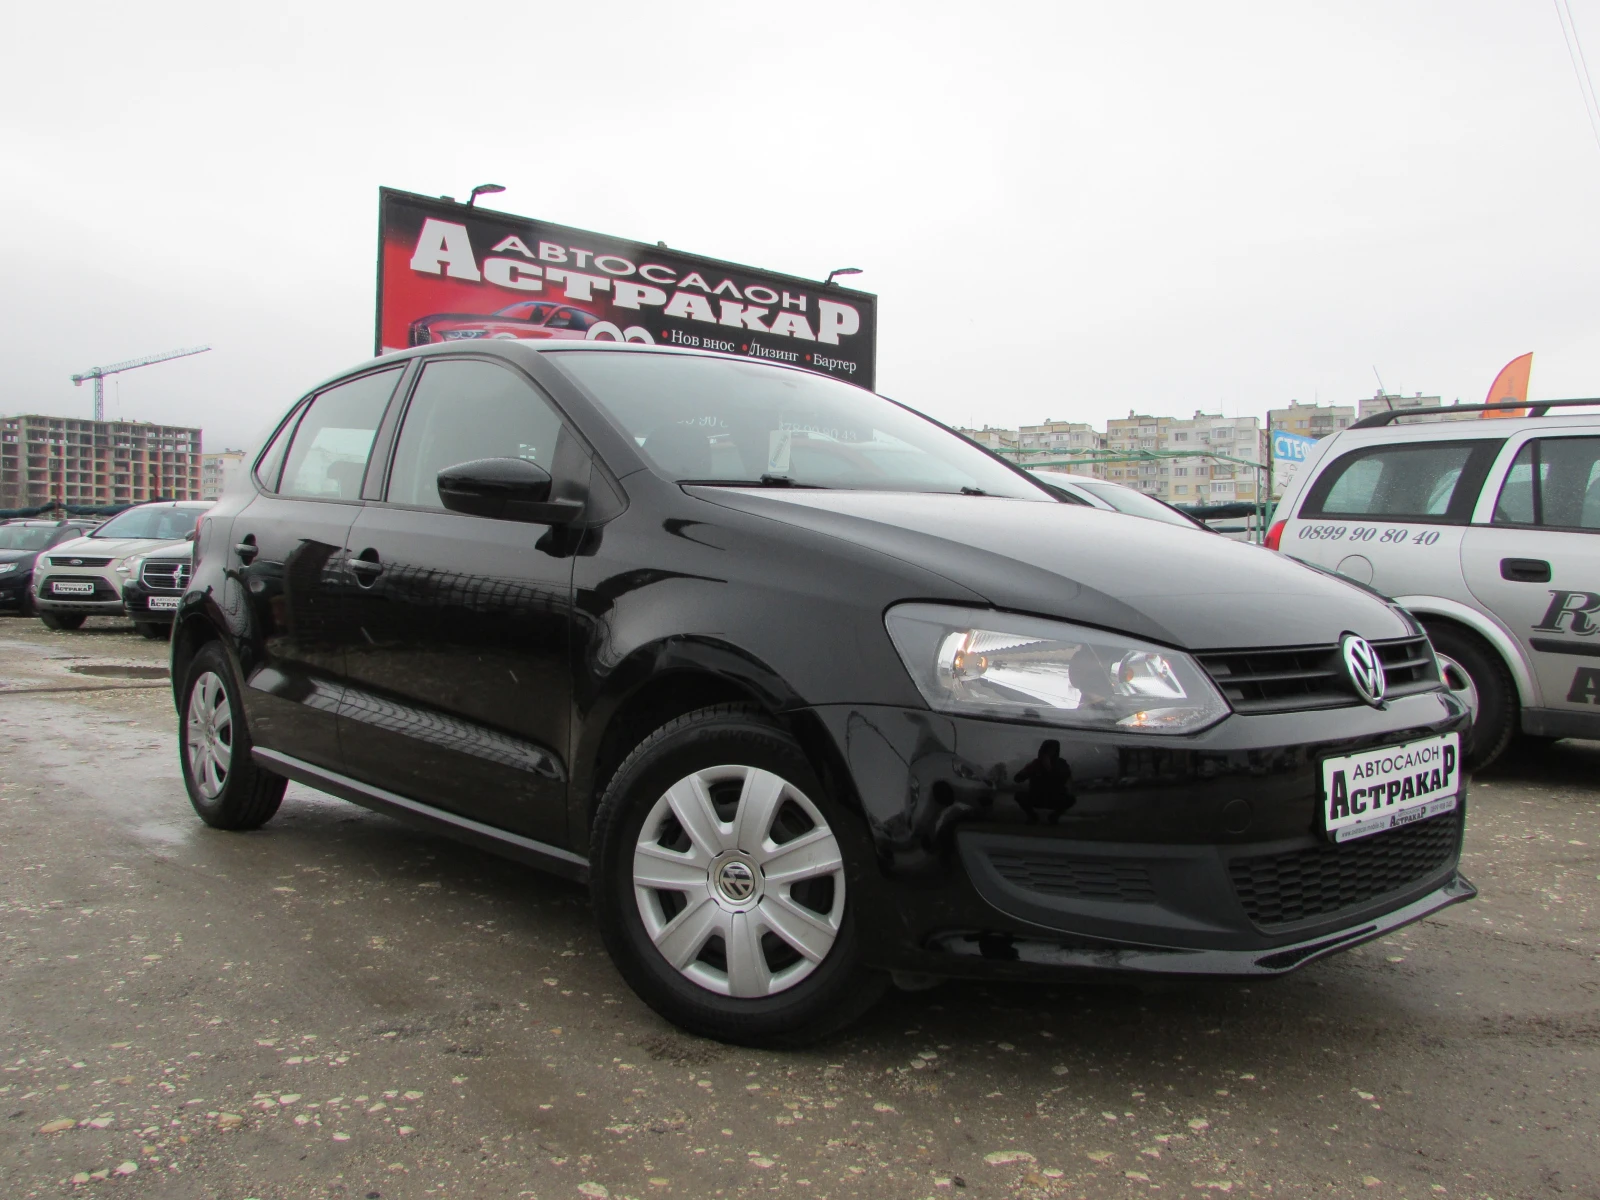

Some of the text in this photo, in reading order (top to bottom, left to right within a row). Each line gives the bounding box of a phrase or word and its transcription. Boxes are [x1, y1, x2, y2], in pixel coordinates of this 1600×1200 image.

[491, 235, 807, 311] АВТОСАЛОН
[671, 329, 699, 346] Нов
[703, 338, 735, 352] внос
[750, 342, 800, 362] Лизинг
[813, 353, 857, 373] Бартер
[1274, 436, 1316, 458] СТЕФ
[1298, 525, 1440, 546] 0899 90 80 40
[1353, 746, 1440, 780] АВТОСАЛОН
